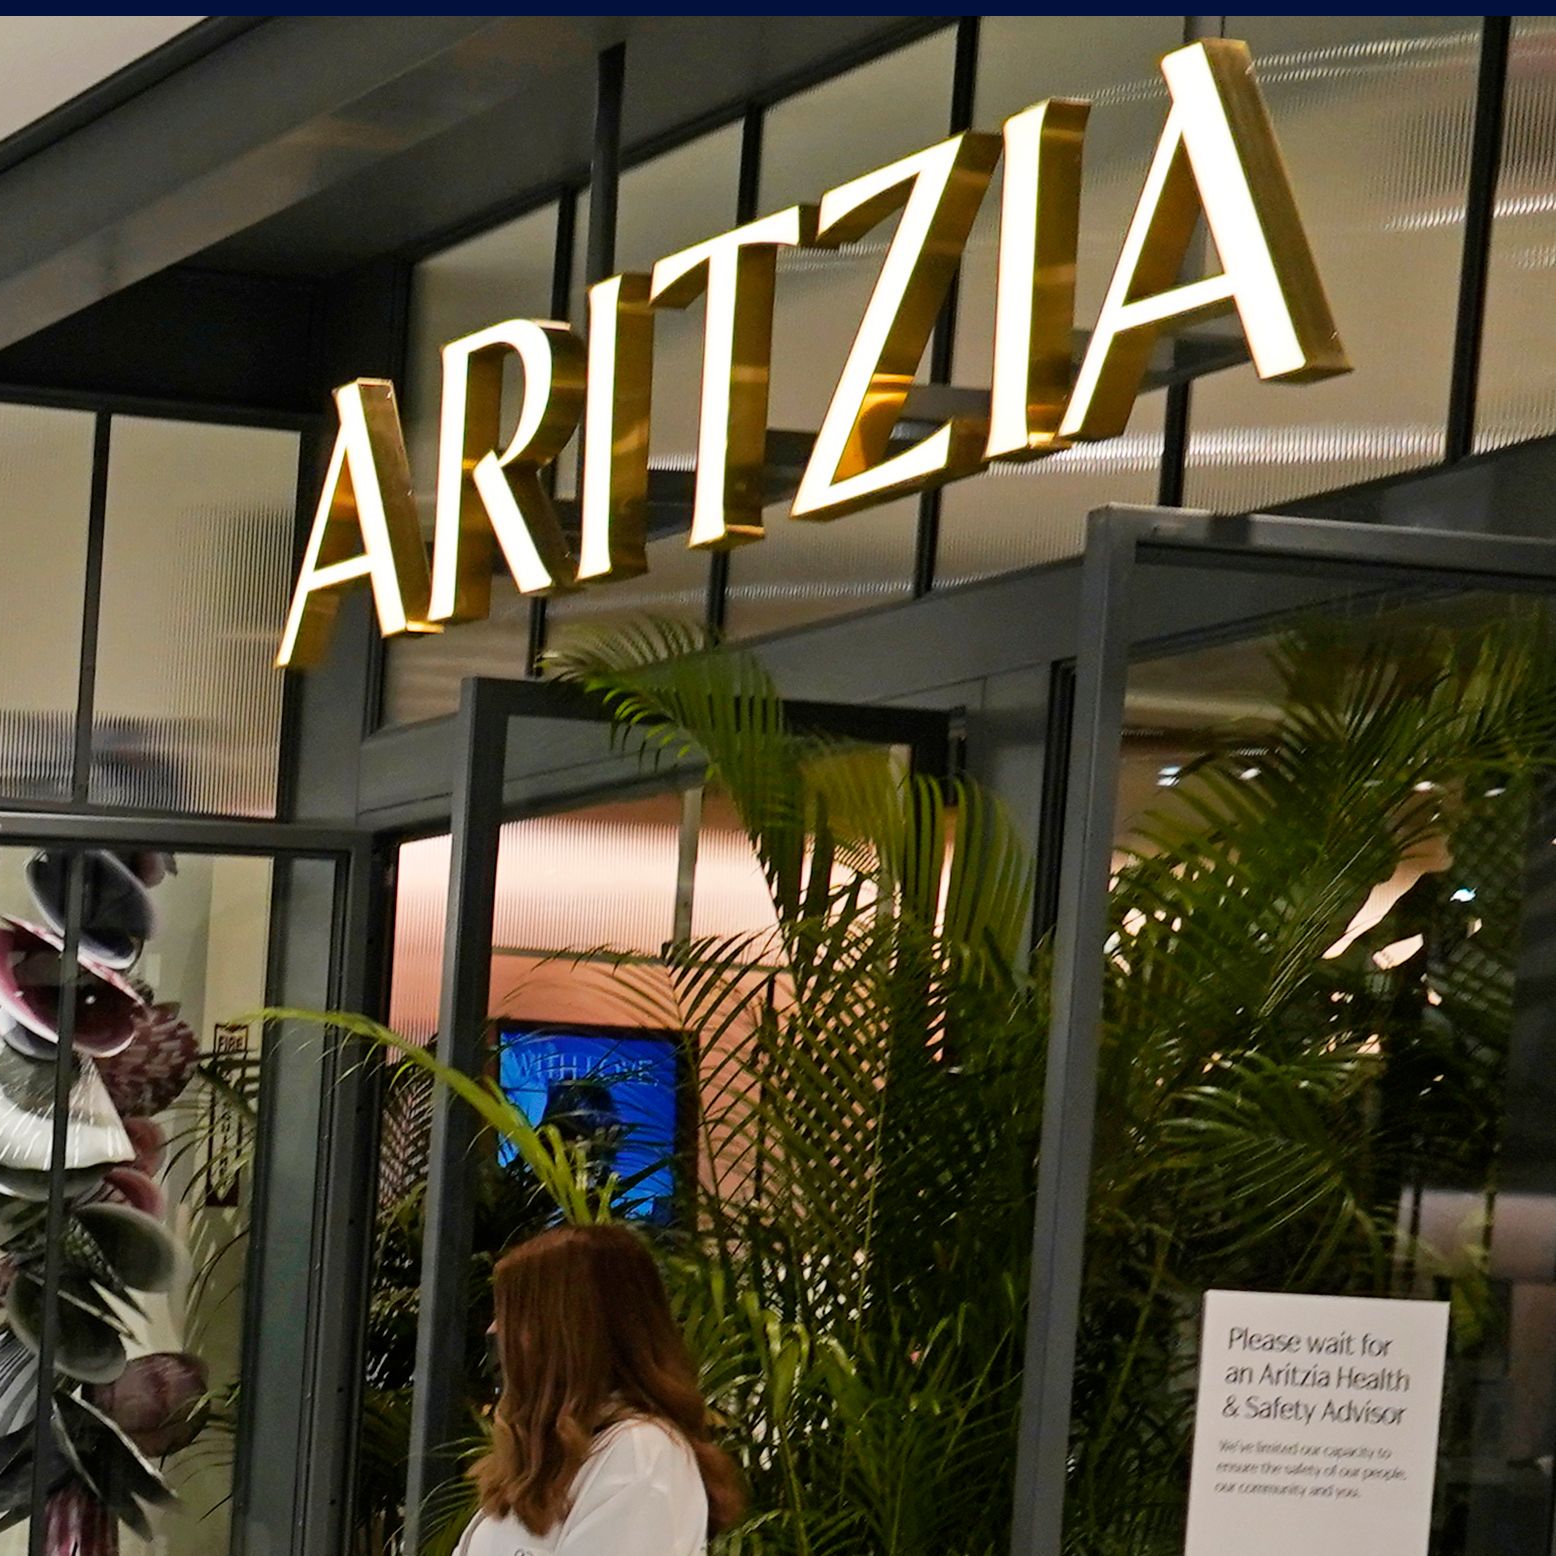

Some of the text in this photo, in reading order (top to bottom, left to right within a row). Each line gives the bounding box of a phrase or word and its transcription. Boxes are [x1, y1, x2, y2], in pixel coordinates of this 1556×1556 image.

[274, 38, 1352, 669] ARITZIA
[1228, 1327, 1394, 1358] Please wait for
[1224, 1362, 1412, 1393] an Aritzia Health
[1222, 1395, 1407, 1426] & Safety Advisor
